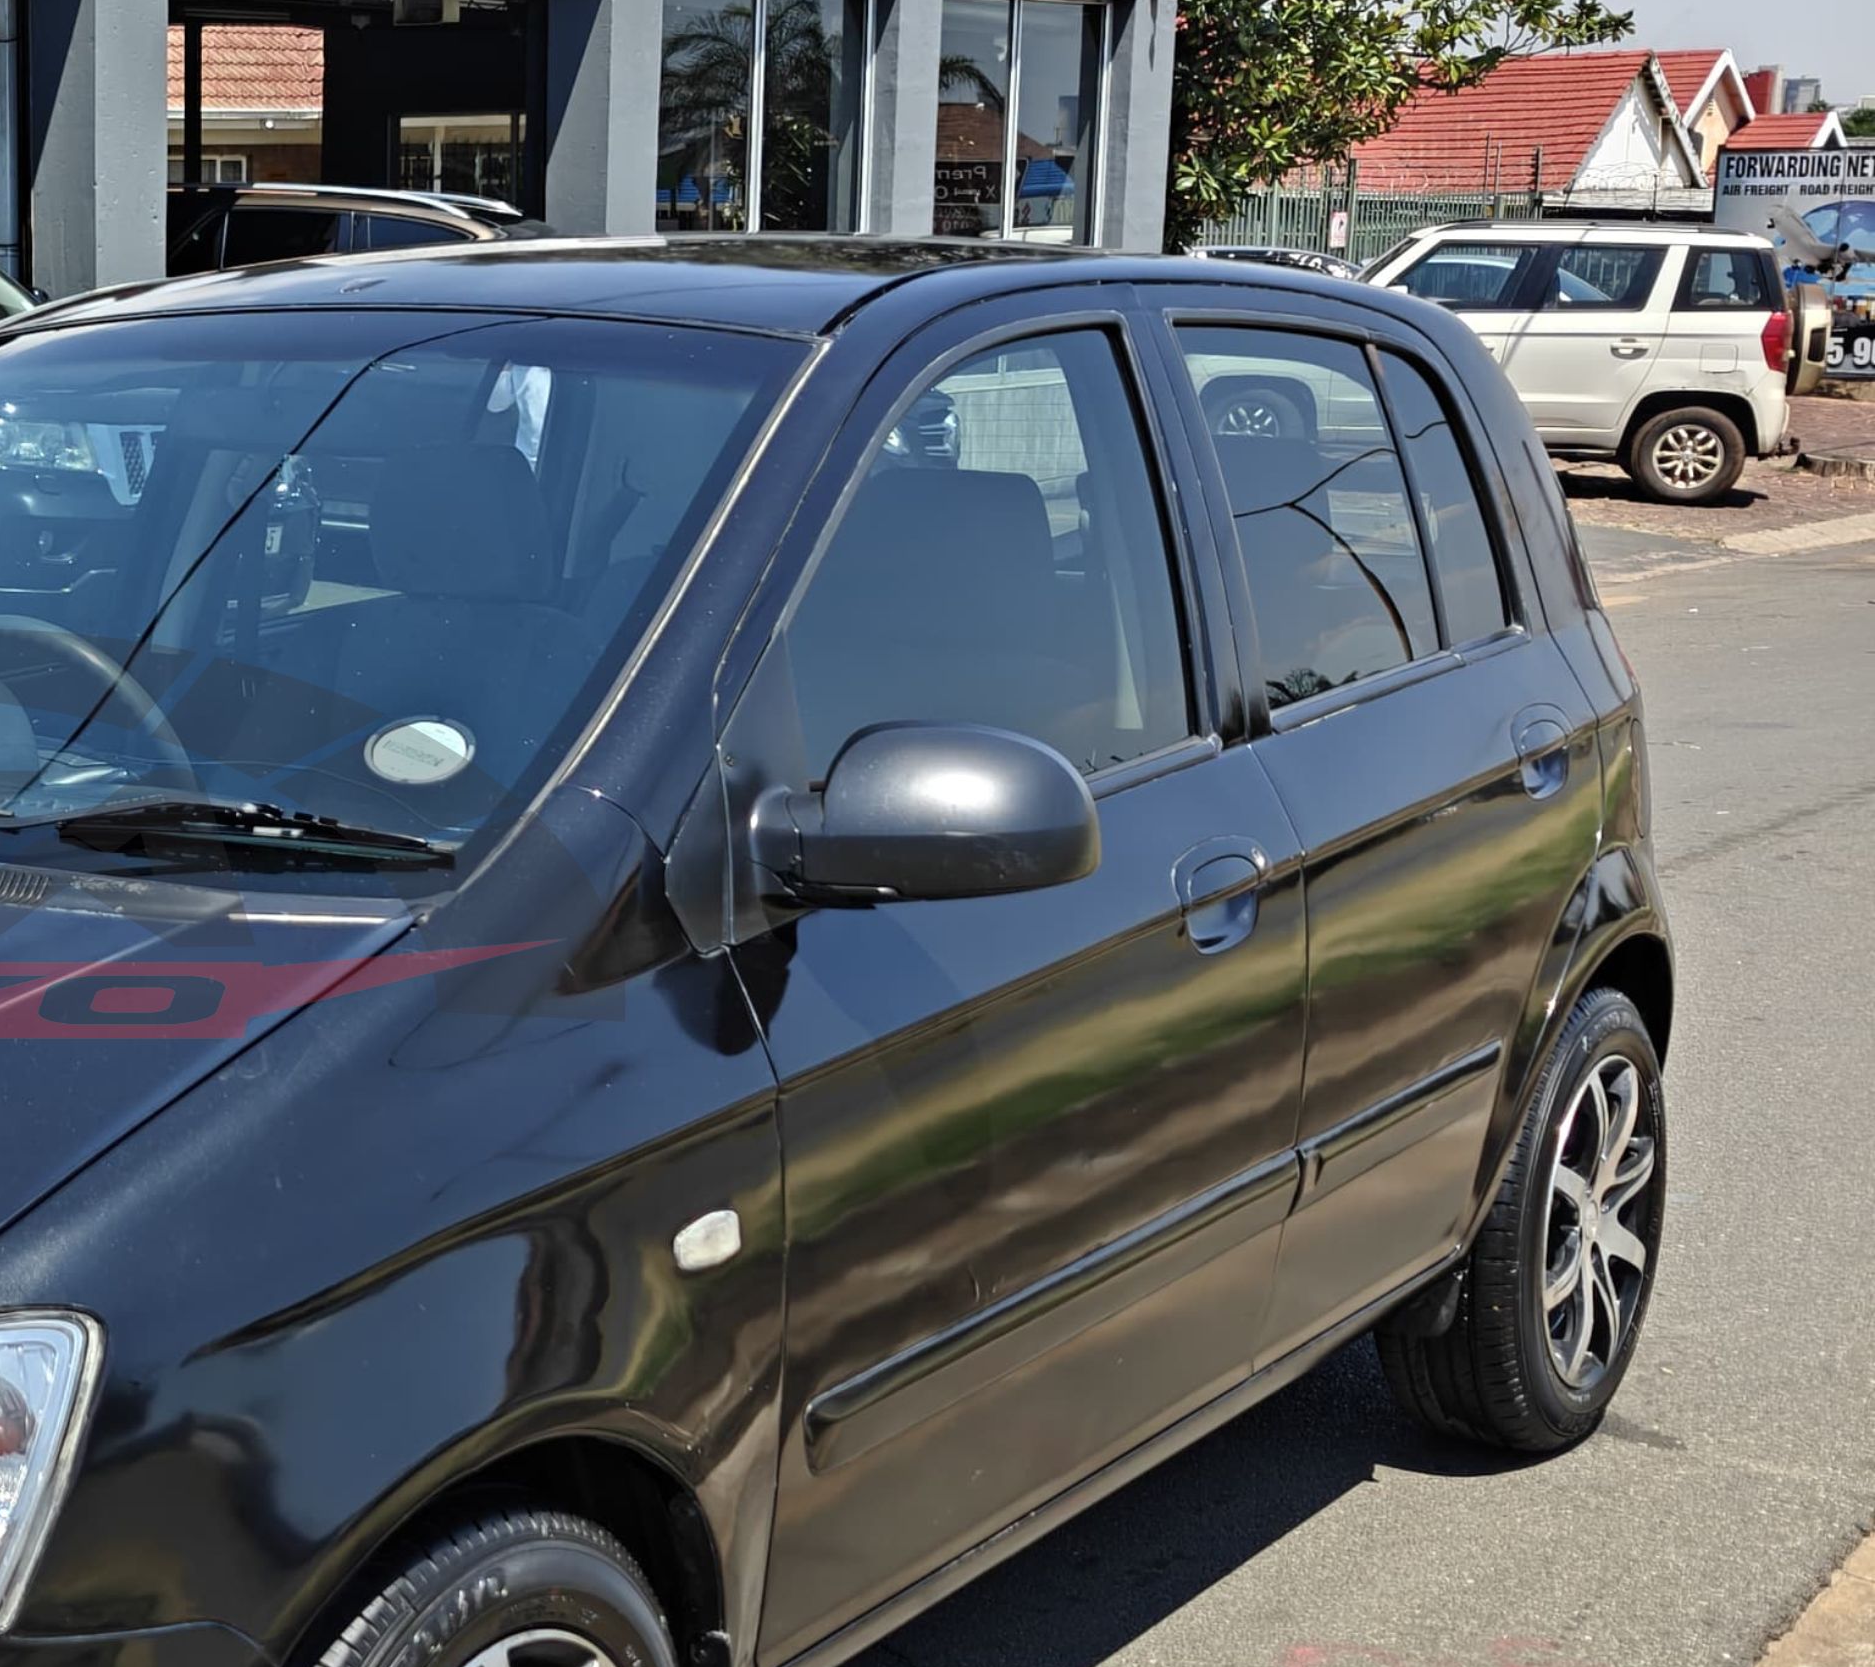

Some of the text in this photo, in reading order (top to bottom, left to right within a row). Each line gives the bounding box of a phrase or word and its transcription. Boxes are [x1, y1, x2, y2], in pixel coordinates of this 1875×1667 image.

[1725, 155, 1875, 178] FORWARDING NE
[1722, 184, 1742, 196] AIR
[1744, 184, 1789, 196] FREIGHT
[1800, 184, 1830, 196] ROAD
